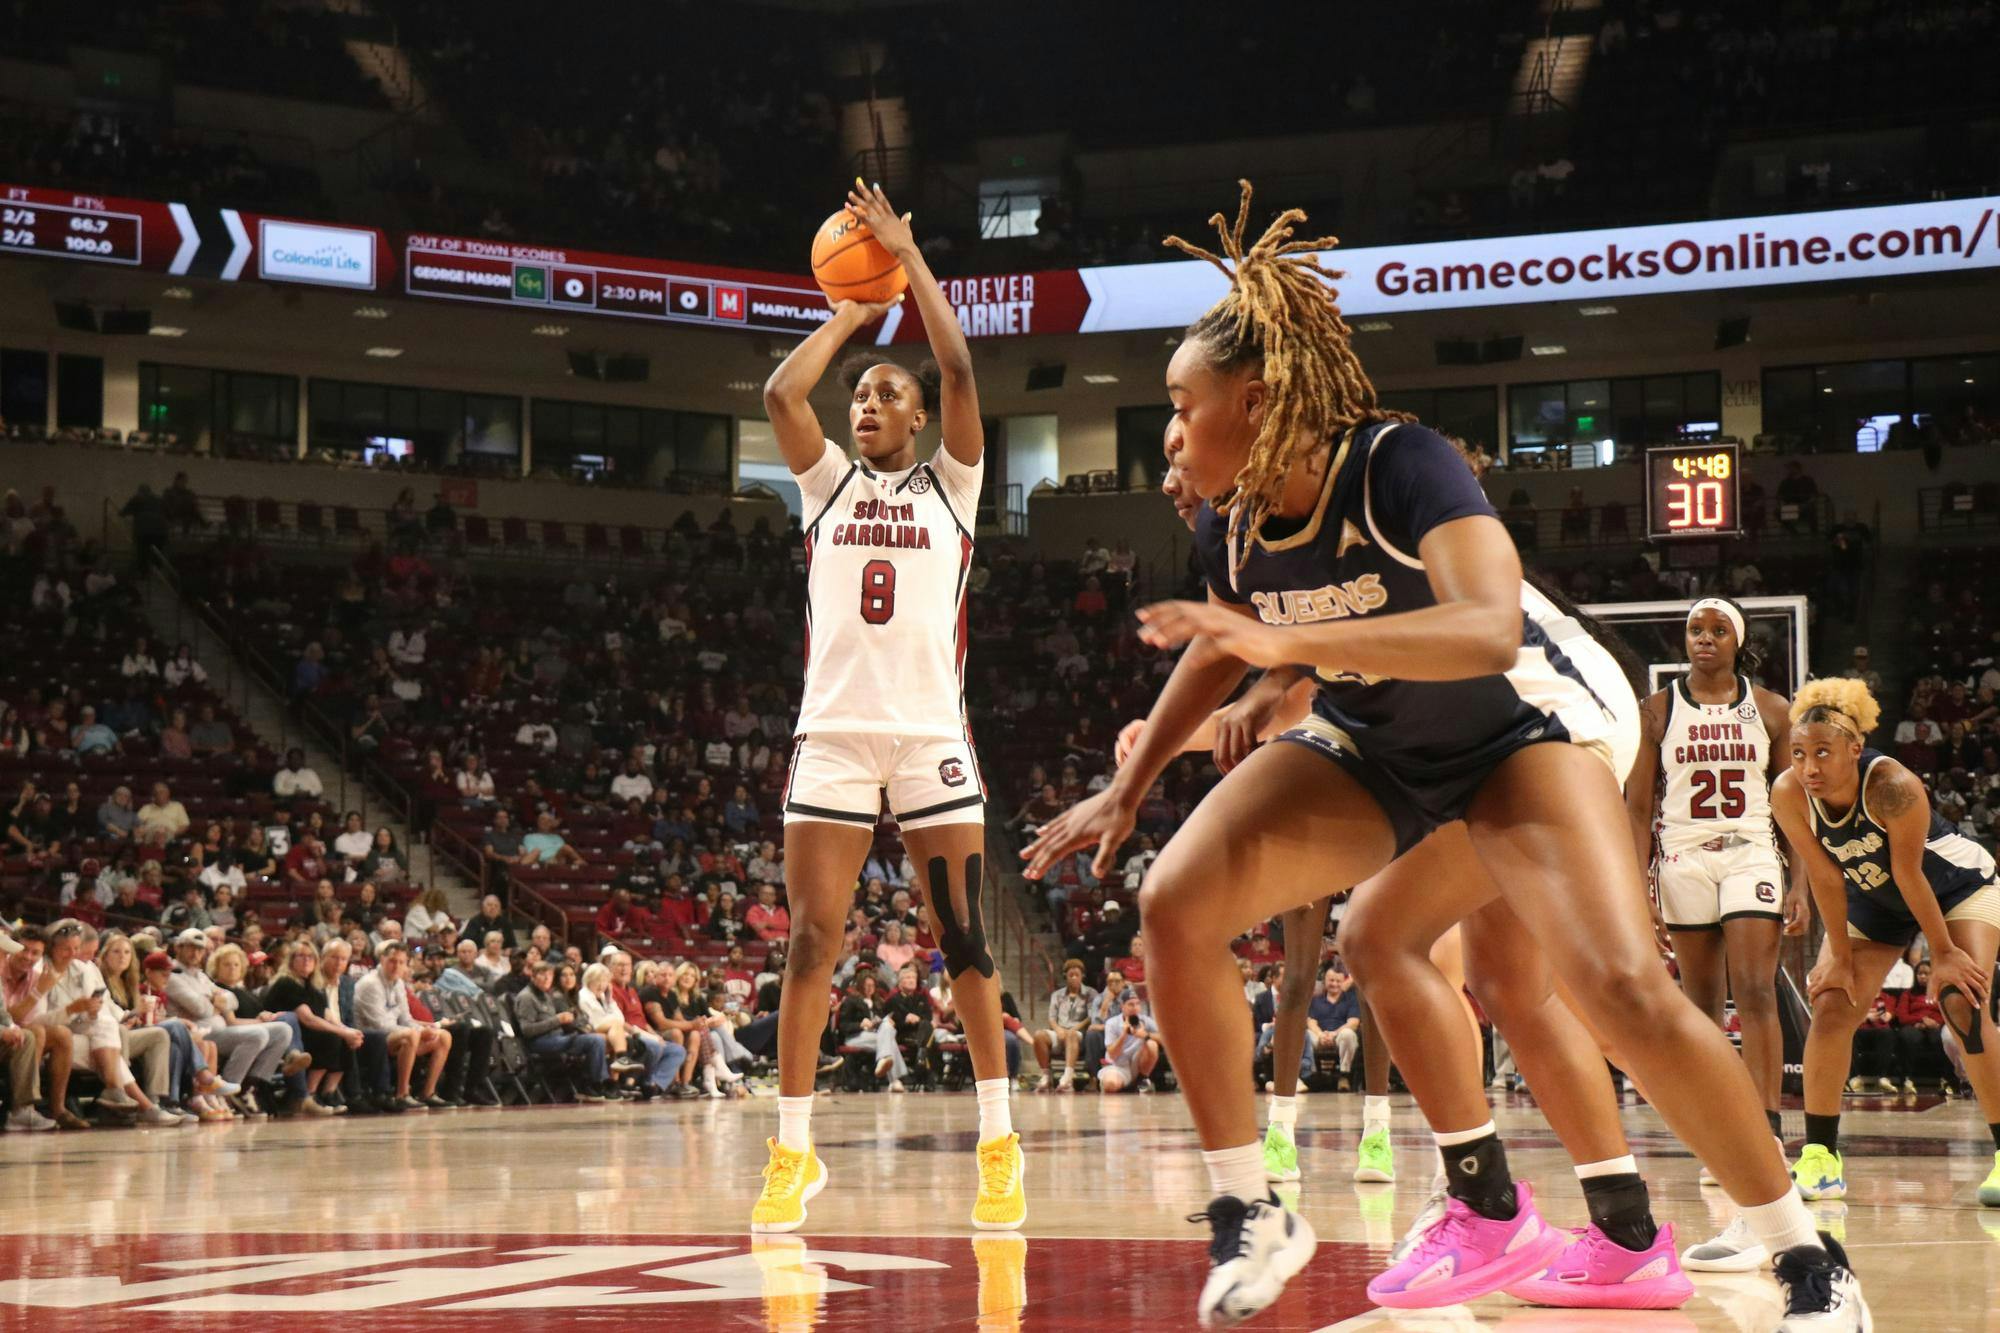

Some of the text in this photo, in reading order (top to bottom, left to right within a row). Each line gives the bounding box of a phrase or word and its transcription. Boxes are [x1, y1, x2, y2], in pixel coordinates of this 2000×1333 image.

[3, 209, 108, 234] 2/3 66.7
[3, 229, 113, 254] 2/2 100.0
[408, 235, 566, 263] OUT OF TOWN SCORES
[272, 248, 361, 271] Colonial Life
[413, 265, 512, 289] GEORGE MASON
[602, 285, 662, 304] 2:30 PM
[721, 292, 737, 312] M
[752, 302, 834, 322] MARYLAND
[951, 301, 1035, 336] ARNET
[1673, 453, 1730, 479] 4:48
[853, 499, 915, 523] SOUTH
[1668, 482, 1723, 527] 30
[832, 523, 931, 550] CAROLINA
[860, 559, 896, 625] 8
[1251, 573, 1388, 625] QUEENS
[1688, 723, 1743, 741] SOUTH
[1675, 743, 1757, 763] CAROLINA
[1690, 769, 1746, 819] 25
[1783, 1063, 1804, 1074] na
